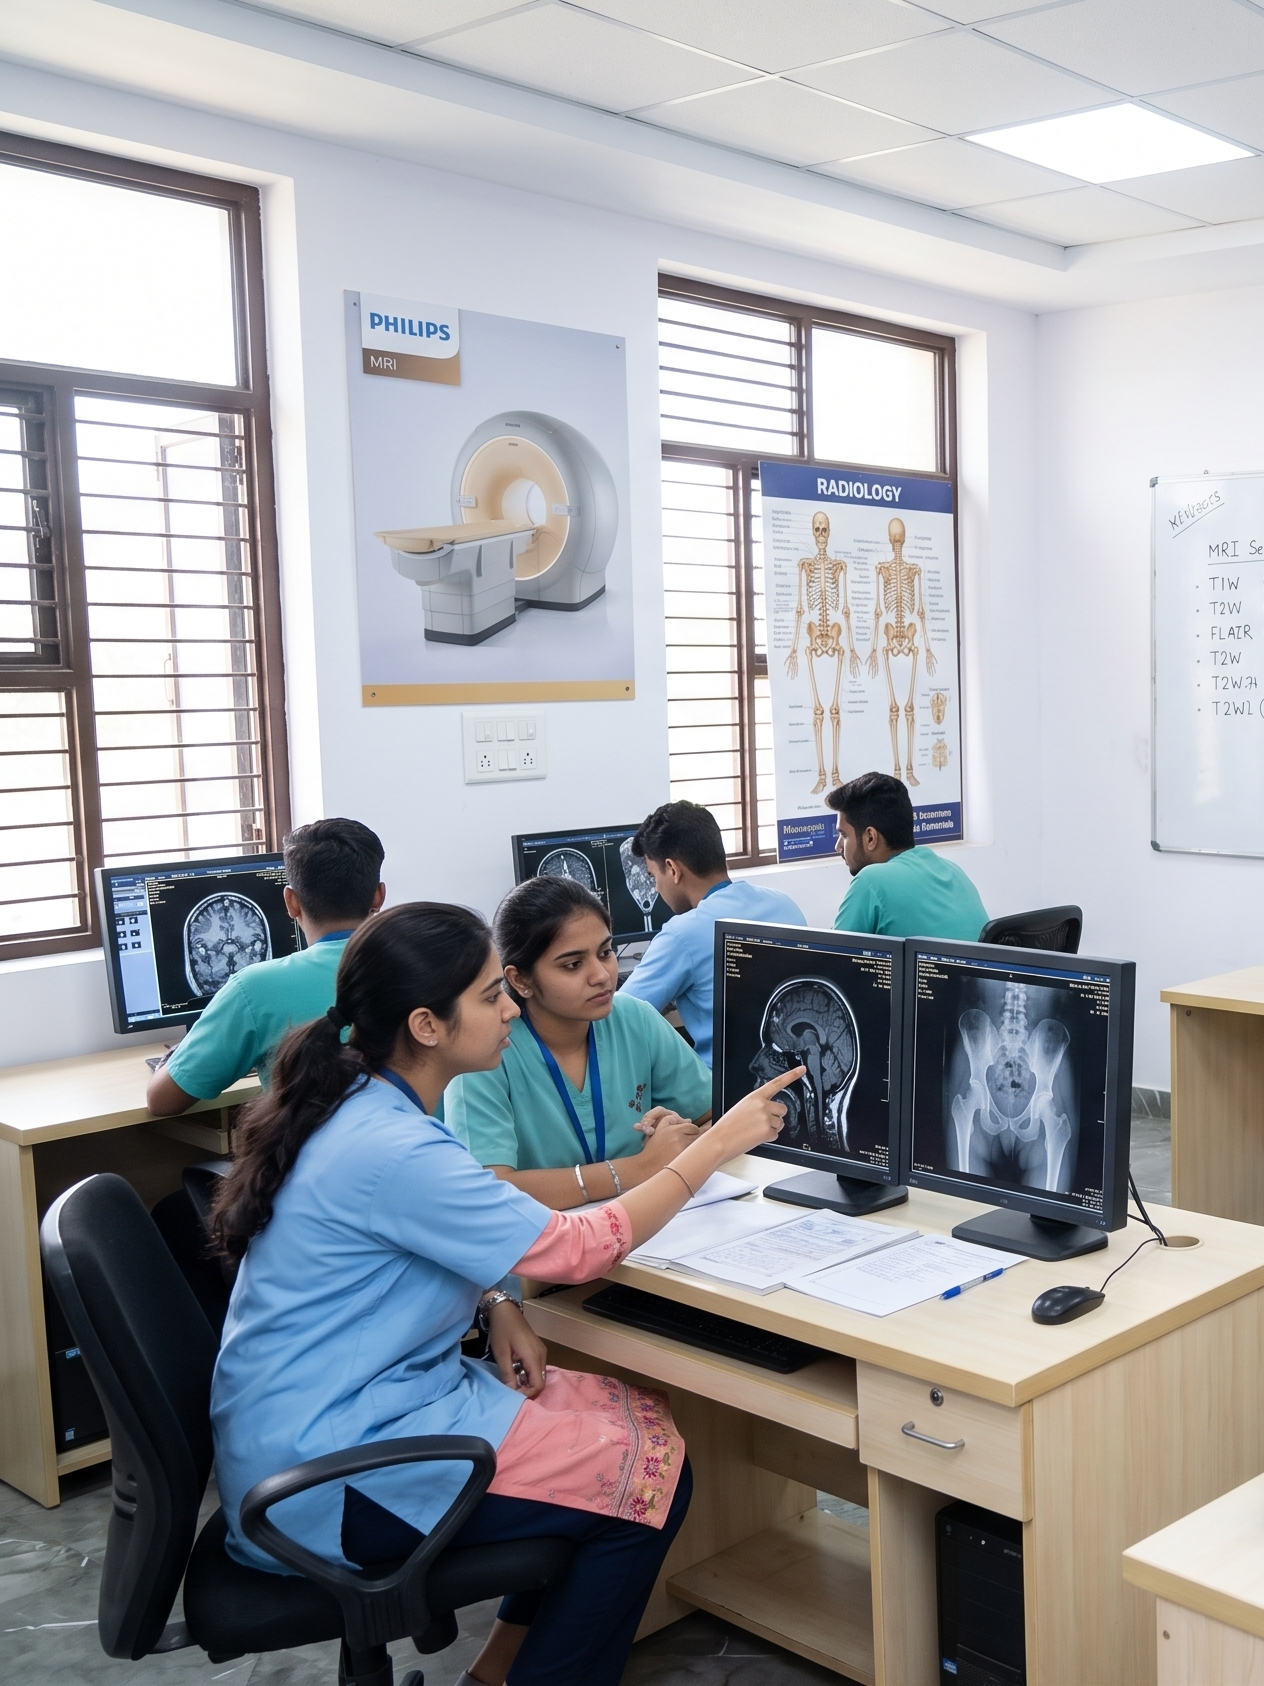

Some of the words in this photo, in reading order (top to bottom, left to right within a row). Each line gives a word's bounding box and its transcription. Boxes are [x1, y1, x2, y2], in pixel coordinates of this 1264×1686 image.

[369, 311, 451, 342] PHILIPS
[370, 355, 397, 371] MRI
[817, 477, 902, 502] RADIOLOGY
[1208, 540, 1240, 558] MRI
[1209, 601, 1242, 615] T2W
[1211, 624, 1253, 640] FLAIR
[1210, 651, 1242, 666] T2W
